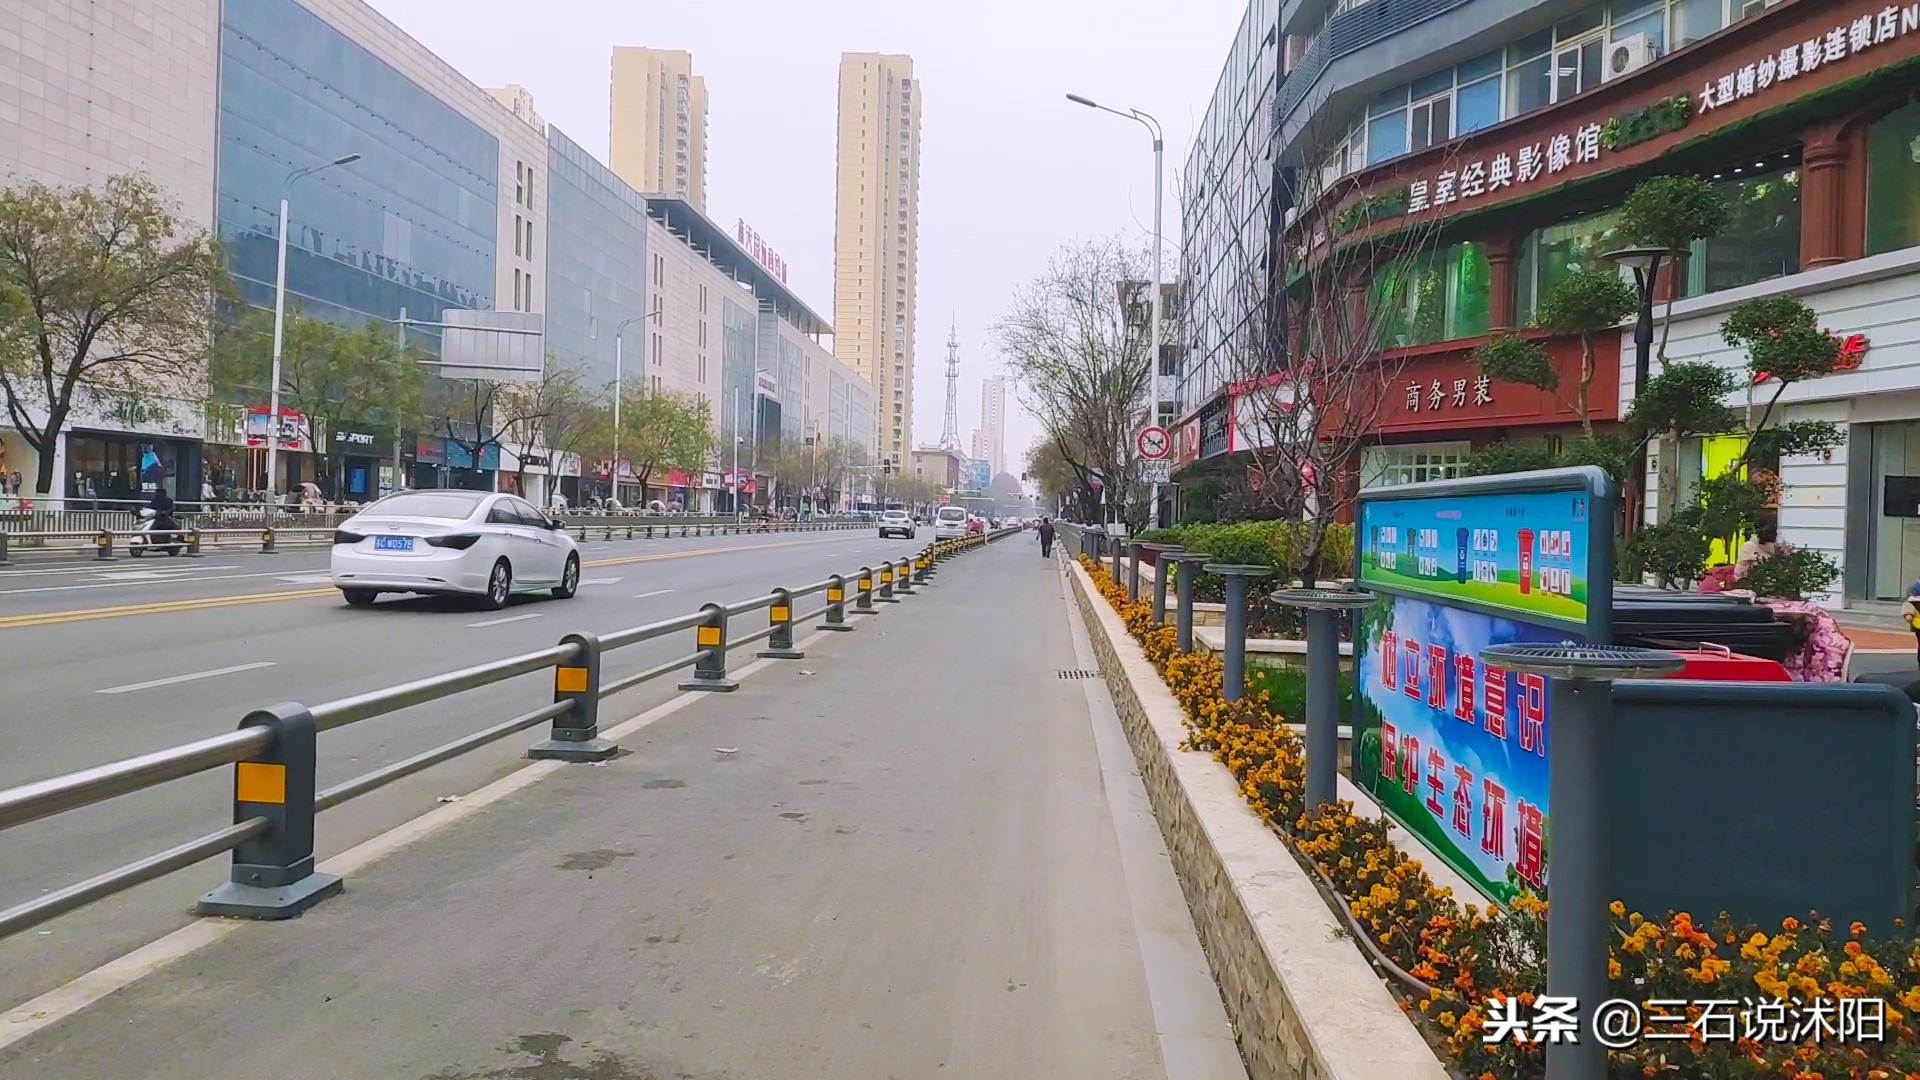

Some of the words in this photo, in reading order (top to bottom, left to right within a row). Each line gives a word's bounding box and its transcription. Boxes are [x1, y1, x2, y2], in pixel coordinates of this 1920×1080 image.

[1698, 4, 1920, 114] 大型婚纱摄影连锁店N
[1408, 122, 1600, 213] 皇室经典影像馆
[1405, 374, 1492, 412] 商务男装
[1381, 630, 1545, 757] 树立环境意识
[1381, 718, 1544, 888] 保护生态环境
